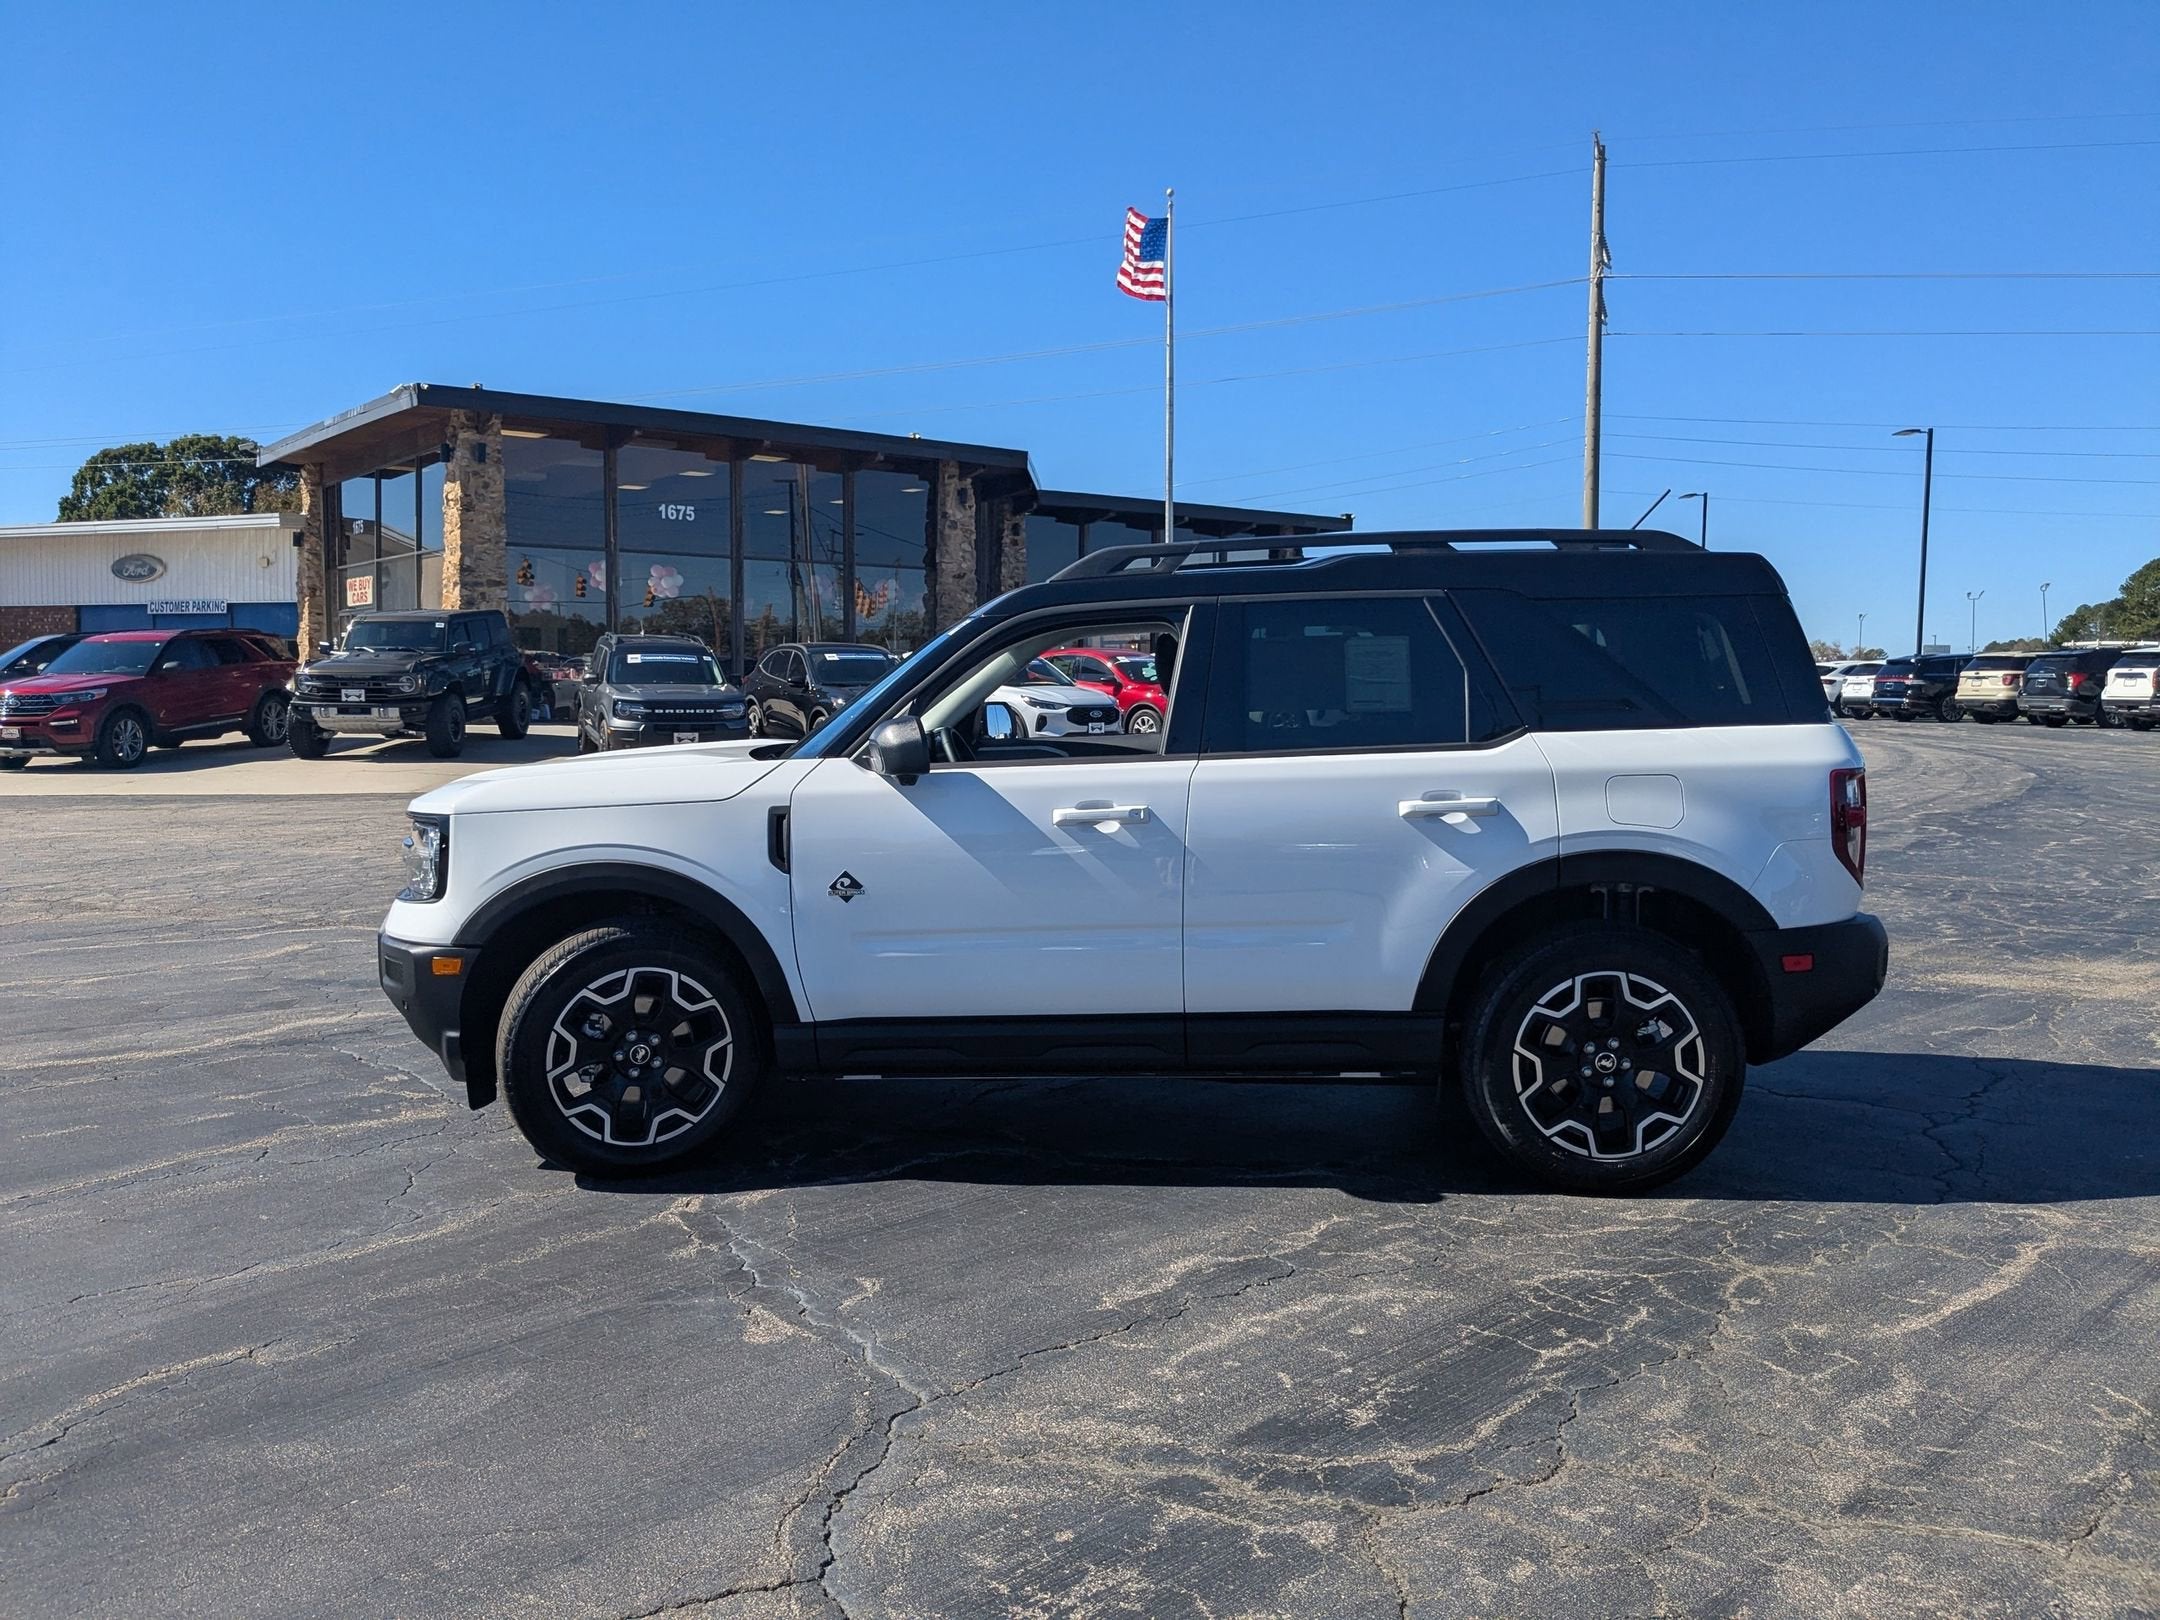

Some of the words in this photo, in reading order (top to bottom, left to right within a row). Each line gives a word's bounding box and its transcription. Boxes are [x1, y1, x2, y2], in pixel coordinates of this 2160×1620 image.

[658, 503, 695, 521] 1675
[123, 564, 149, 577] Ford
[348, 580, 358, 593] WE
[359, 578, 371, 591] BUY
[352, 592, 368, 604] CARS
[149, 601, 190, 613] CUSTOMER
[191, 600, 226, 612] PARKING
